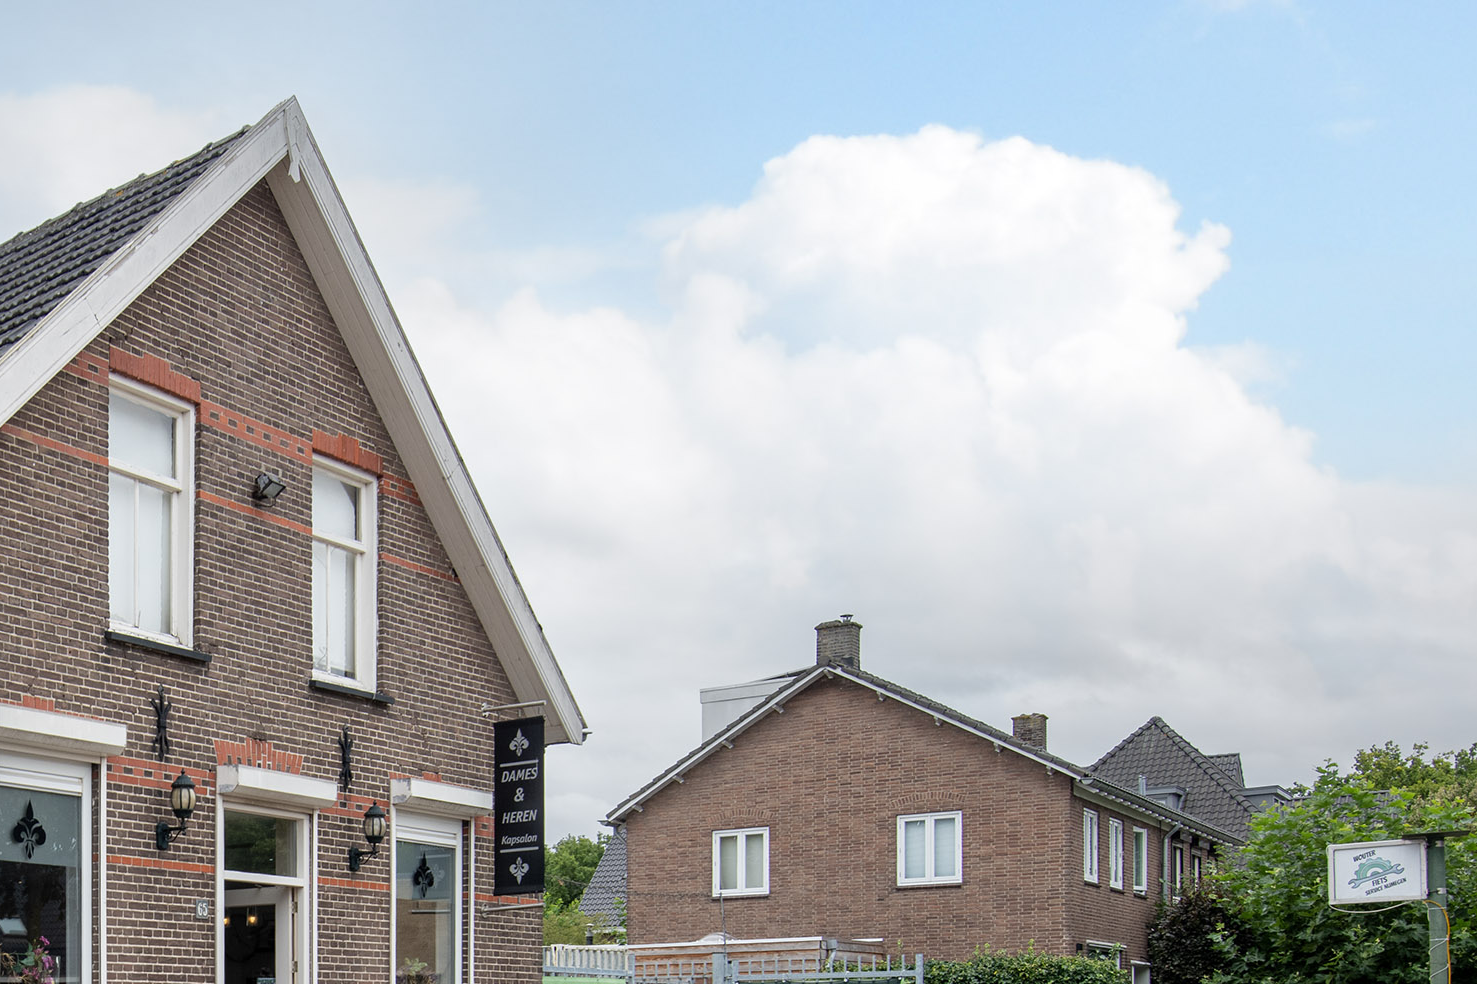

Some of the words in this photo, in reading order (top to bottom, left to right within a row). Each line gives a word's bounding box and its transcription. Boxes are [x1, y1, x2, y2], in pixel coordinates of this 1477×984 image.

[501, 767, 538, 783] DAMES
[513, 787, 524, 802] &
[502, 809, 537, 824] HEREN
[501, 833, 537, 846] Kapsalon
[1353, 850, 1376, 862] WOUTER
[1372, 876, 1388, 886] FIETS
[198, 902, 208, 916] 65
